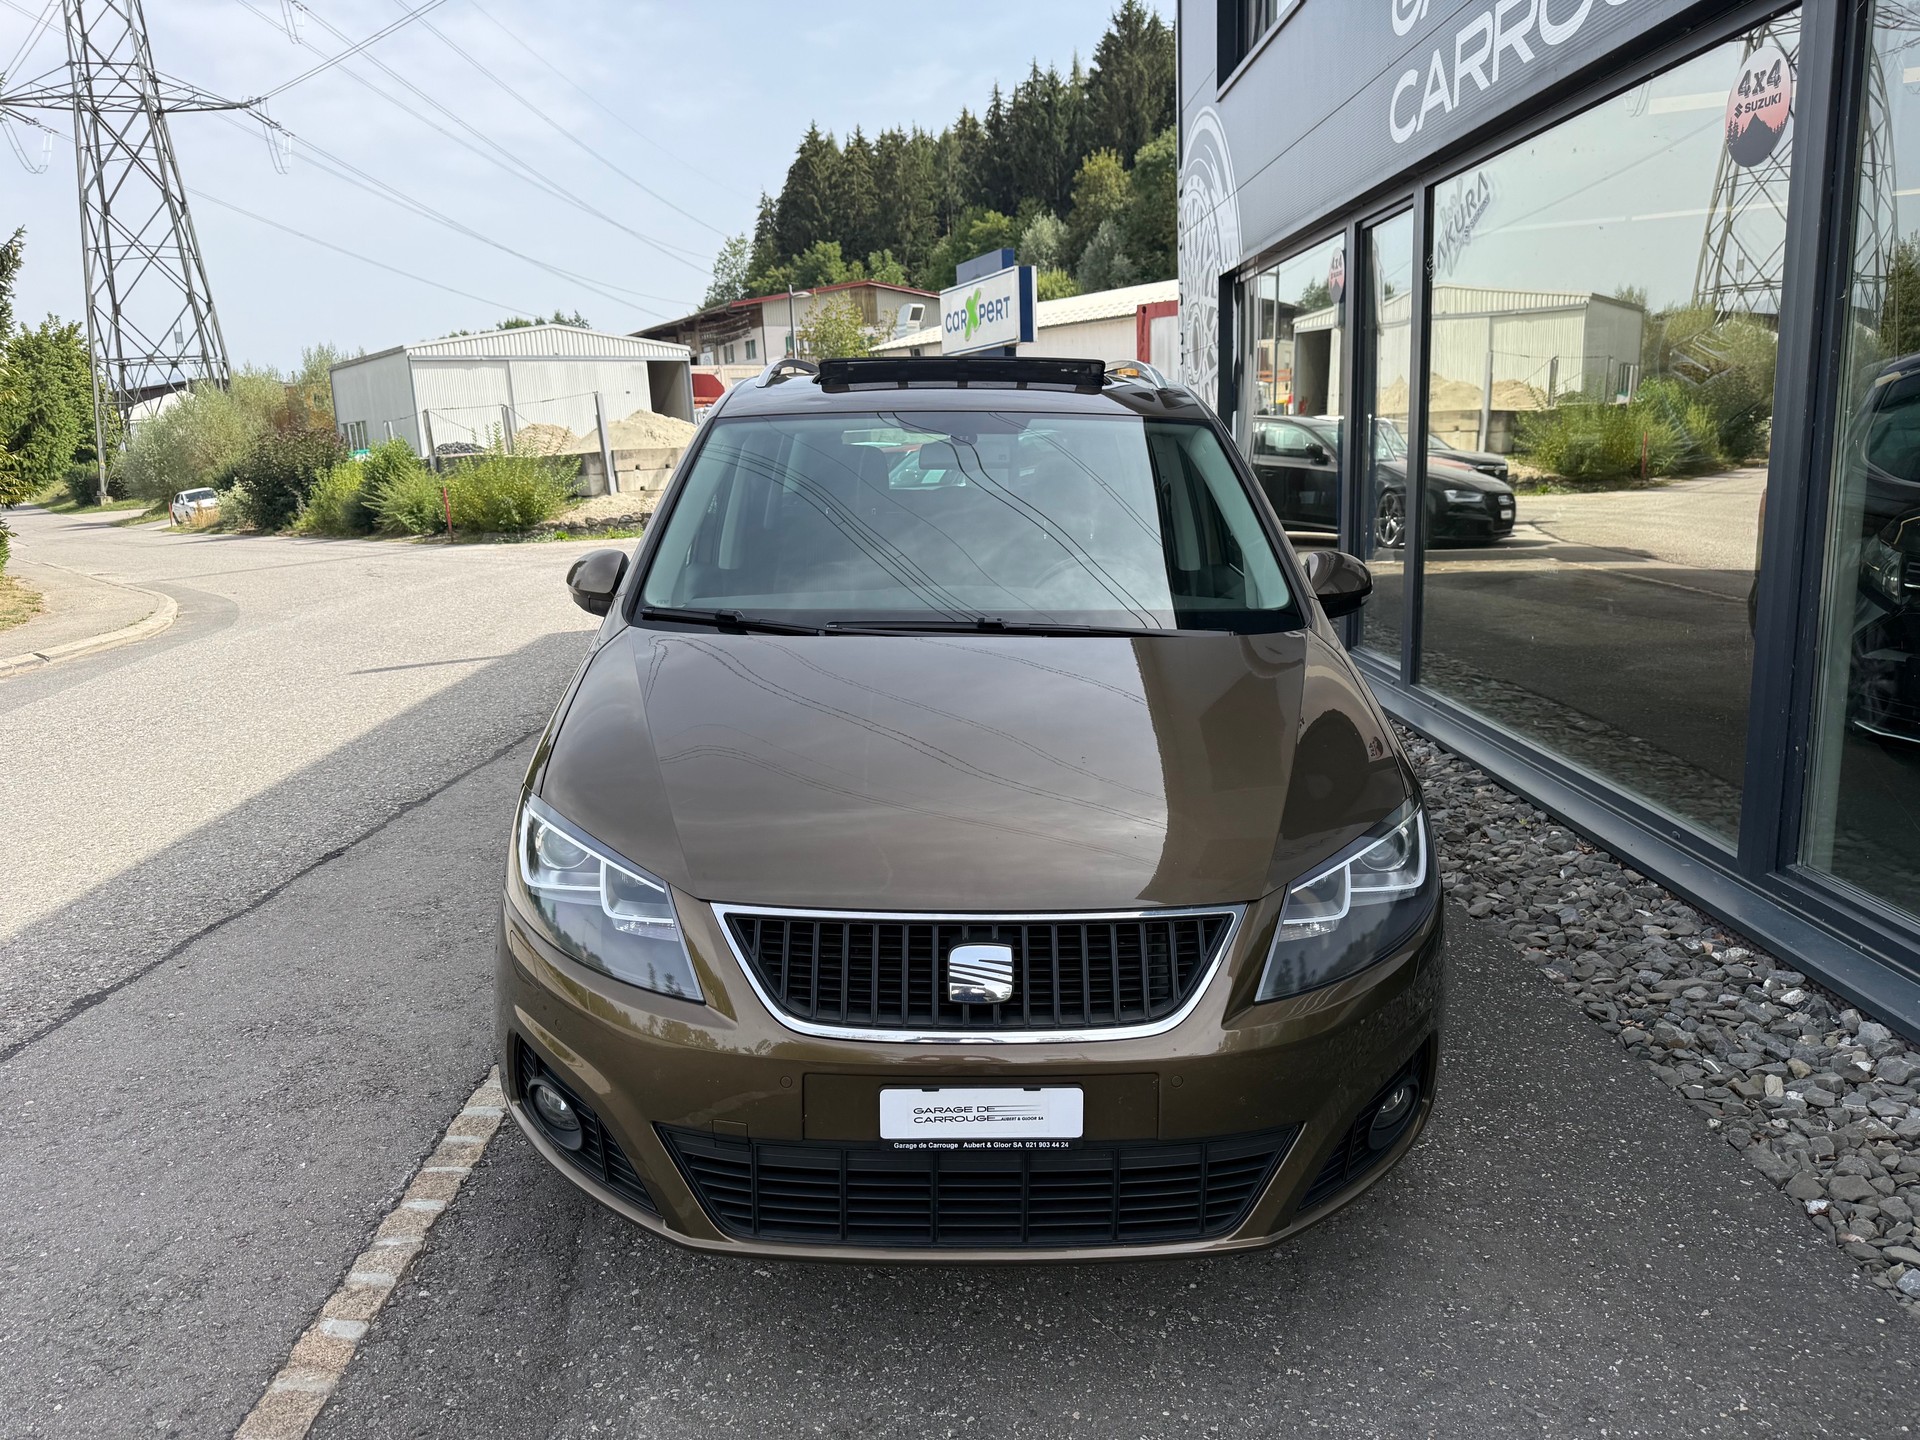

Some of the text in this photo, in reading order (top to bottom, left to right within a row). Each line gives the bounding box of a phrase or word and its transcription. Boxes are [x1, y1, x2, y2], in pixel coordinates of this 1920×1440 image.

[1389, 0, 1628, 144] CARRO
[1737, 58, 1782, 98] 4x4
[1744, 93, 1782, 114] SUZUKI
[913, 1106, 973, 1115] GARAGE
[913, 1115, 996, 1124] CARROUGE
